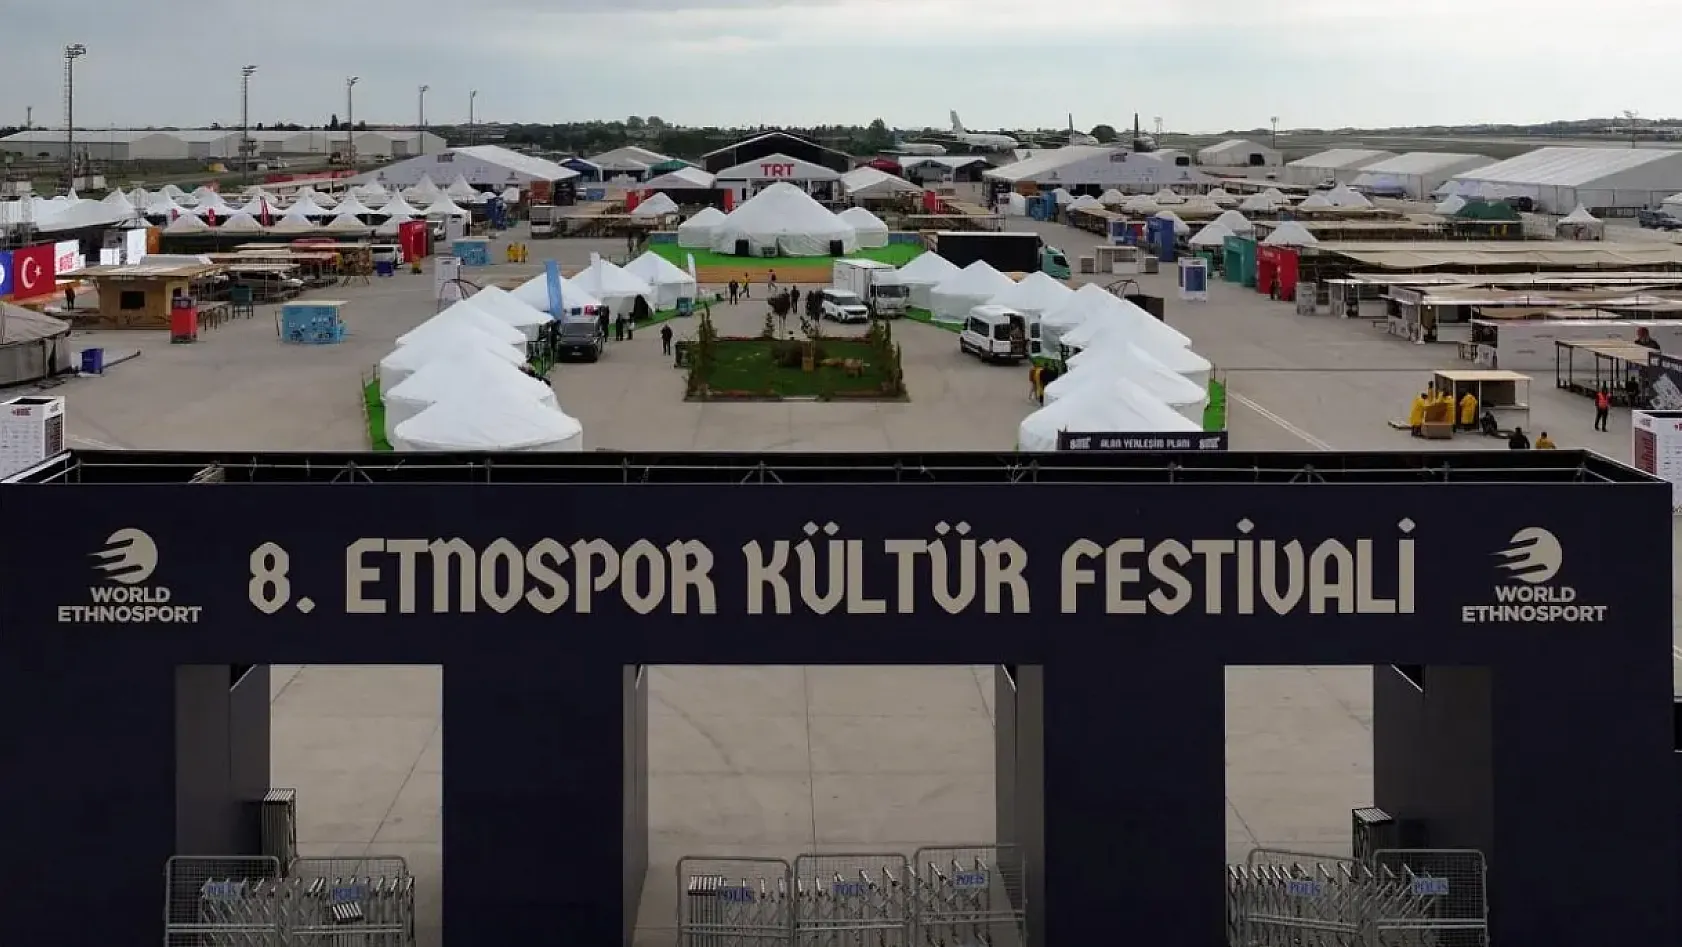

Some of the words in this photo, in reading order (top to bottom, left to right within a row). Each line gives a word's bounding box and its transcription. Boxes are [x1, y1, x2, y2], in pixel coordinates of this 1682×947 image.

[760, 163, 795, 176] TRT
[1101, 438, 1121, 449] ALAN
[248, 541, 316, 614] 8.
[346, 537, 717, 615] ETNOSPOR
[742, 521, 1030, 615] KÜLTÜR
[1061, 517, 1416, 615] FESTİVALİ
[90, 586, 171, 603] WORLD
[1495, 585, 1576, 603] WORLD
[57, 605, 203, 623] ETHNOSPORT
[1462, 605, 1607, 622] ETHNOSPORT
